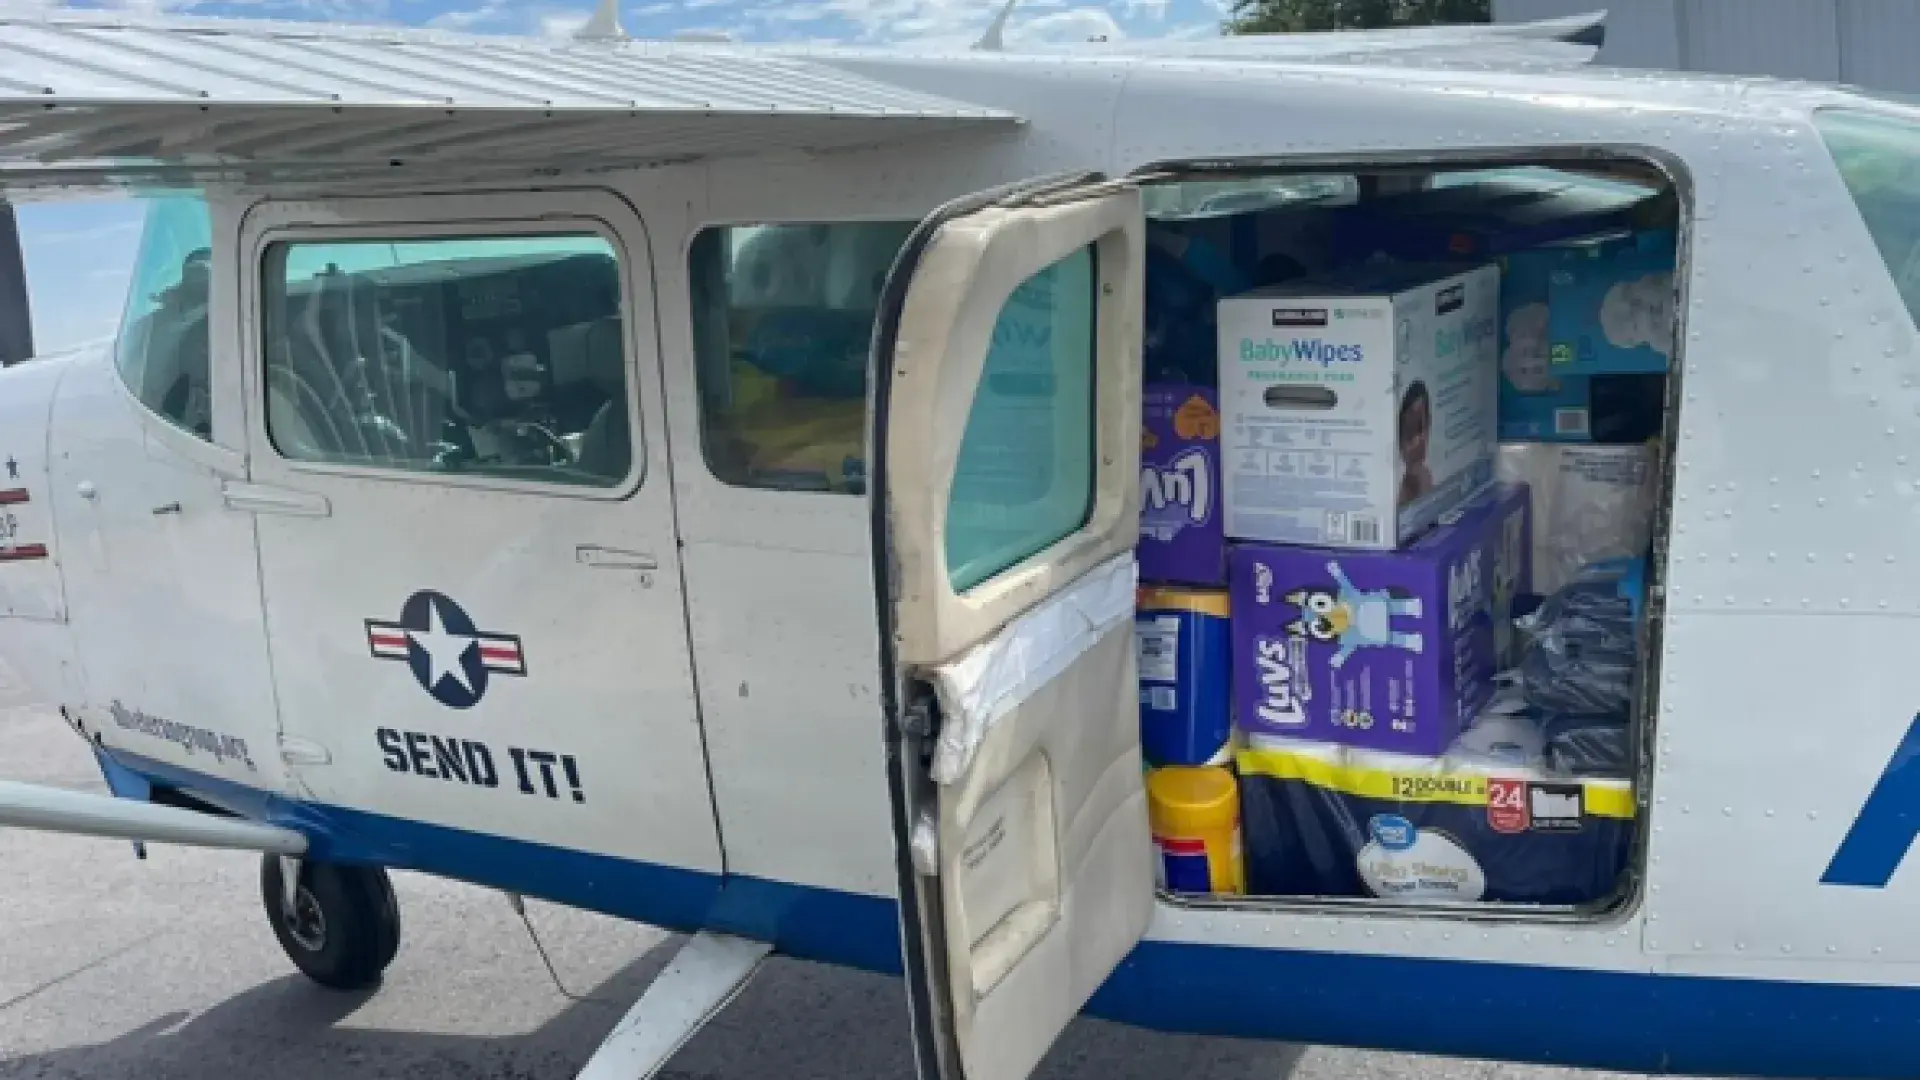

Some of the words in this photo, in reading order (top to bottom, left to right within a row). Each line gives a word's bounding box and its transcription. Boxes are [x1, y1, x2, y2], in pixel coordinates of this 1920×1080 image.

[1141, 451, 1208, 520] Luv
[375, 726, 499, 788] SEND
[508, 747, 586, 804] IT!
[1393, 777, 1412, 797] 12
[1489, 783, 1524, 811] 24
